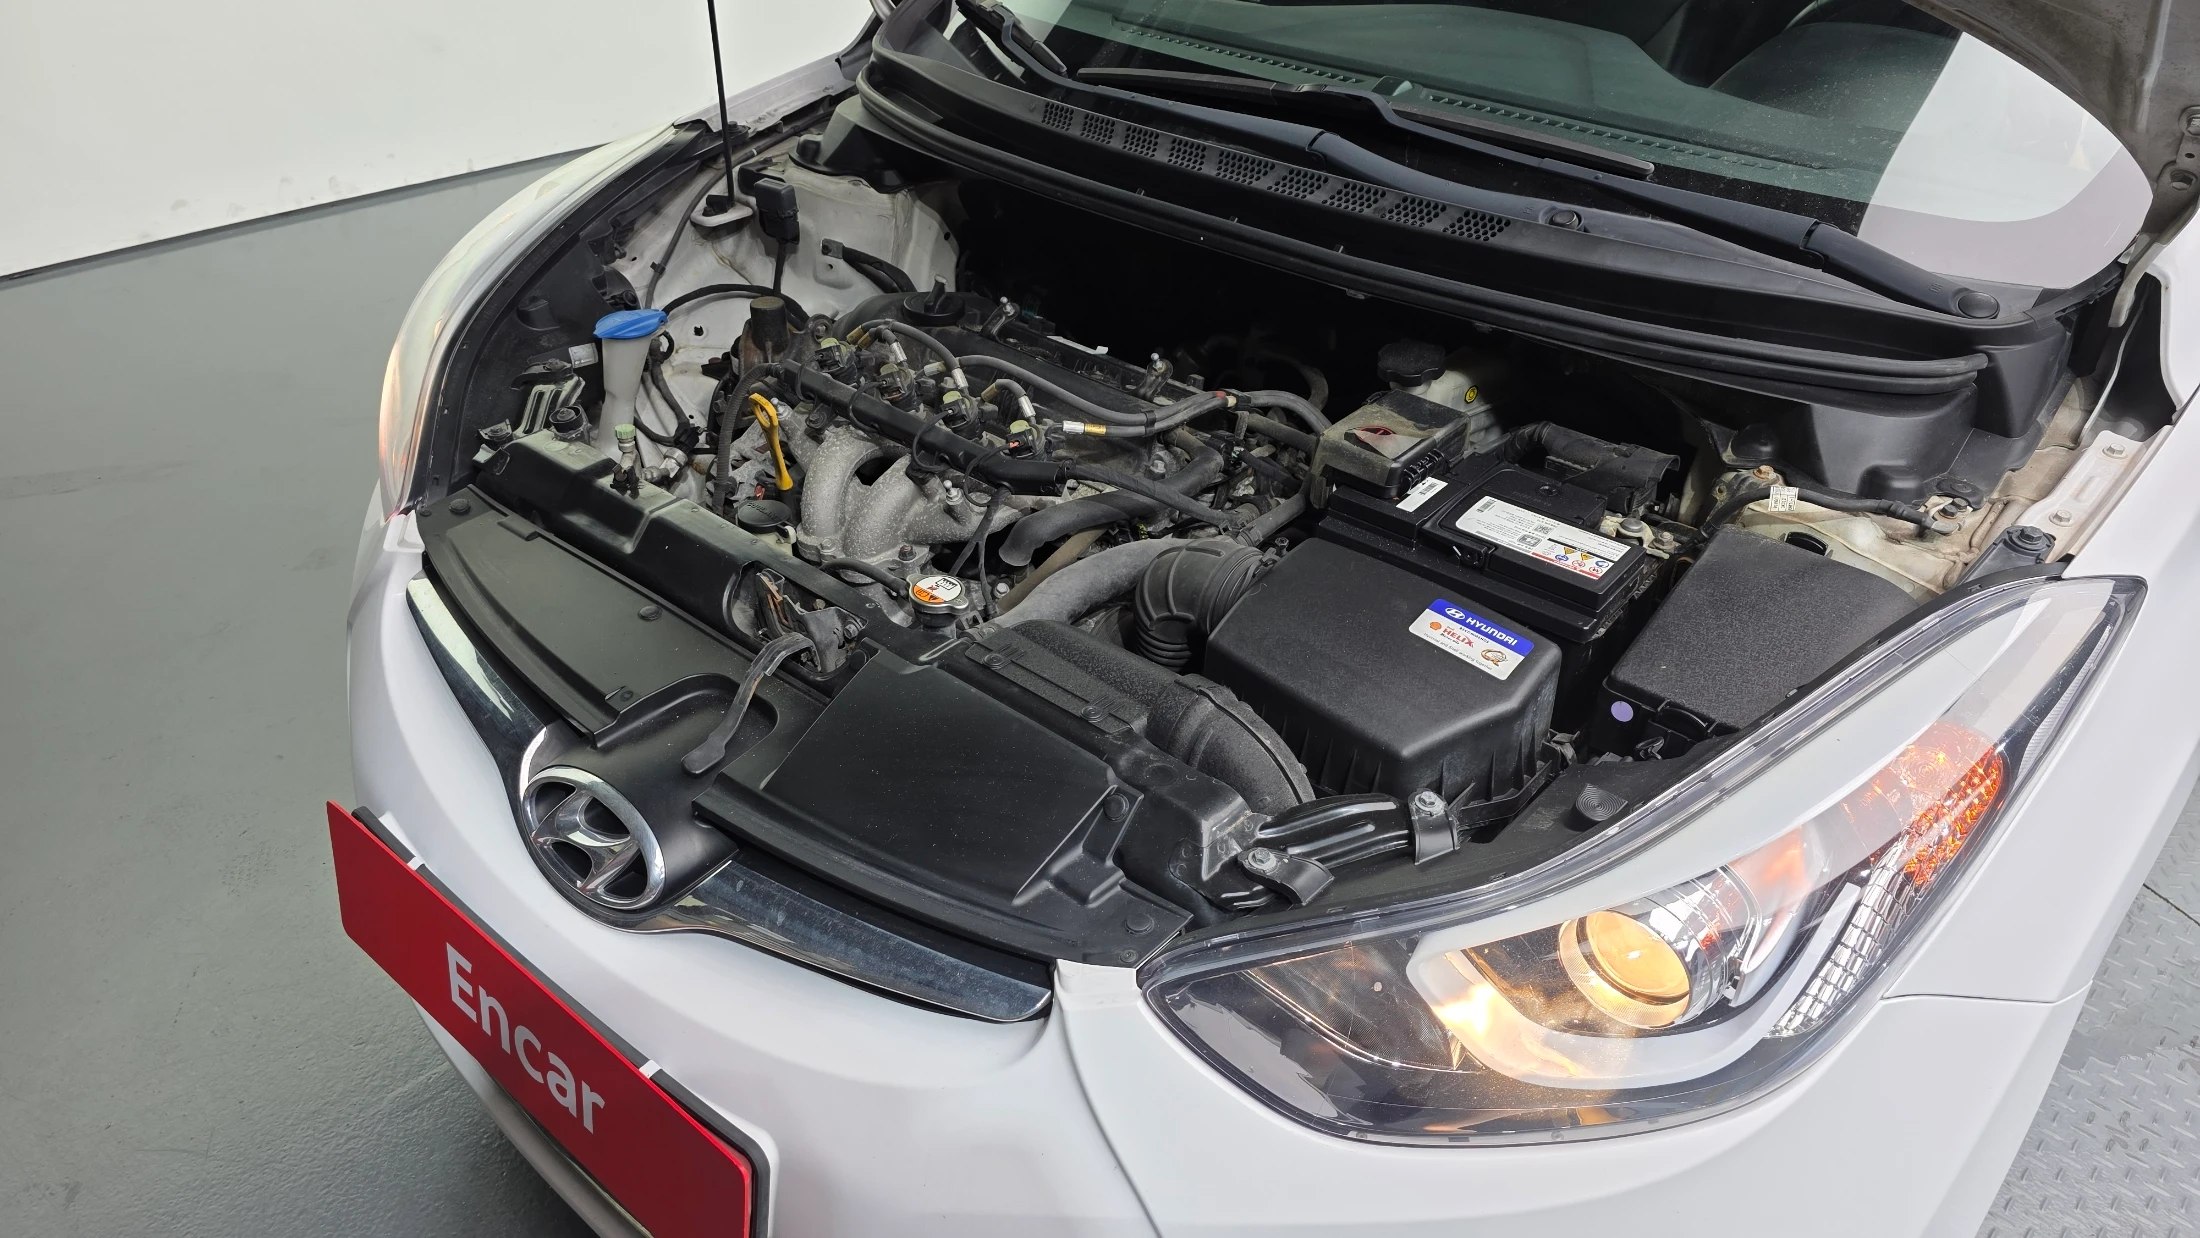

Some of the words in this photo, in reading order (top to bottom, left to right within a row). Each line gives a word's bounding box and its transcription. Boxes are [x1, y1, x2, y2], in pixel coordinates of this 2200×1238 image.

[1443, 628, 1474, 648] HELIX
[1466, 617, 1518, 646] HYUNDAI
[446, 943, 605, 1134] Encar
